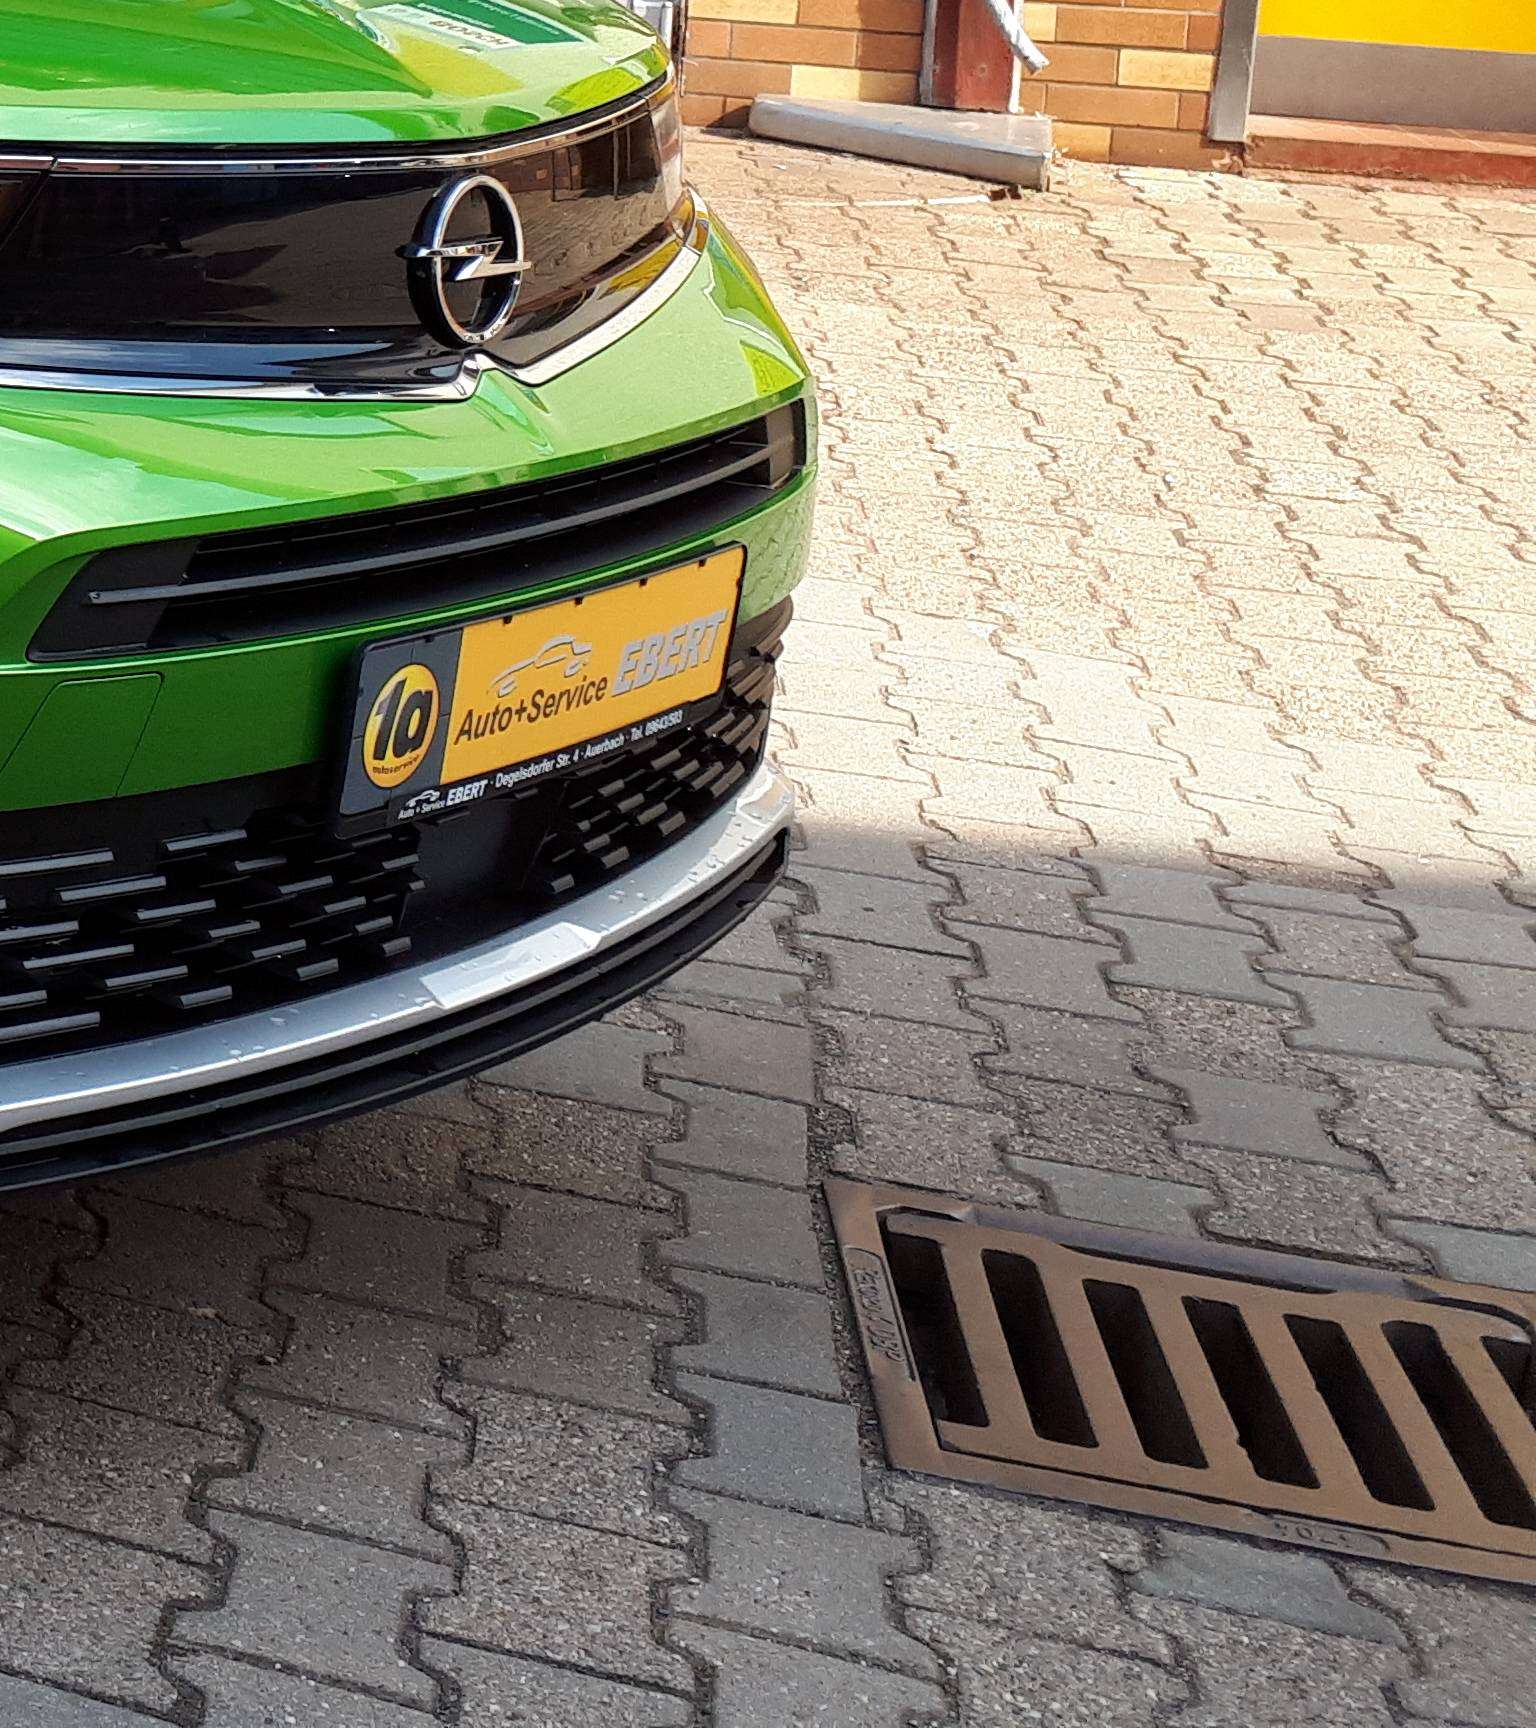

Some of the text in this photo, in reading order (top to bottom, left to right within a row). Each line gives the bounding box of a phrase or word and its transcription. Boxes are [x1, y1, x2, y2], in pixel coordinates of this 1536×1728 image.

[611, 608, 729, 698] EBERT
[374, 677, 434, 761] 1a
[453, 674, 609, 746] Auto+Service
[445, 778, 489, 807] EBERT
[583, 733, 625, 759] Auerbach
